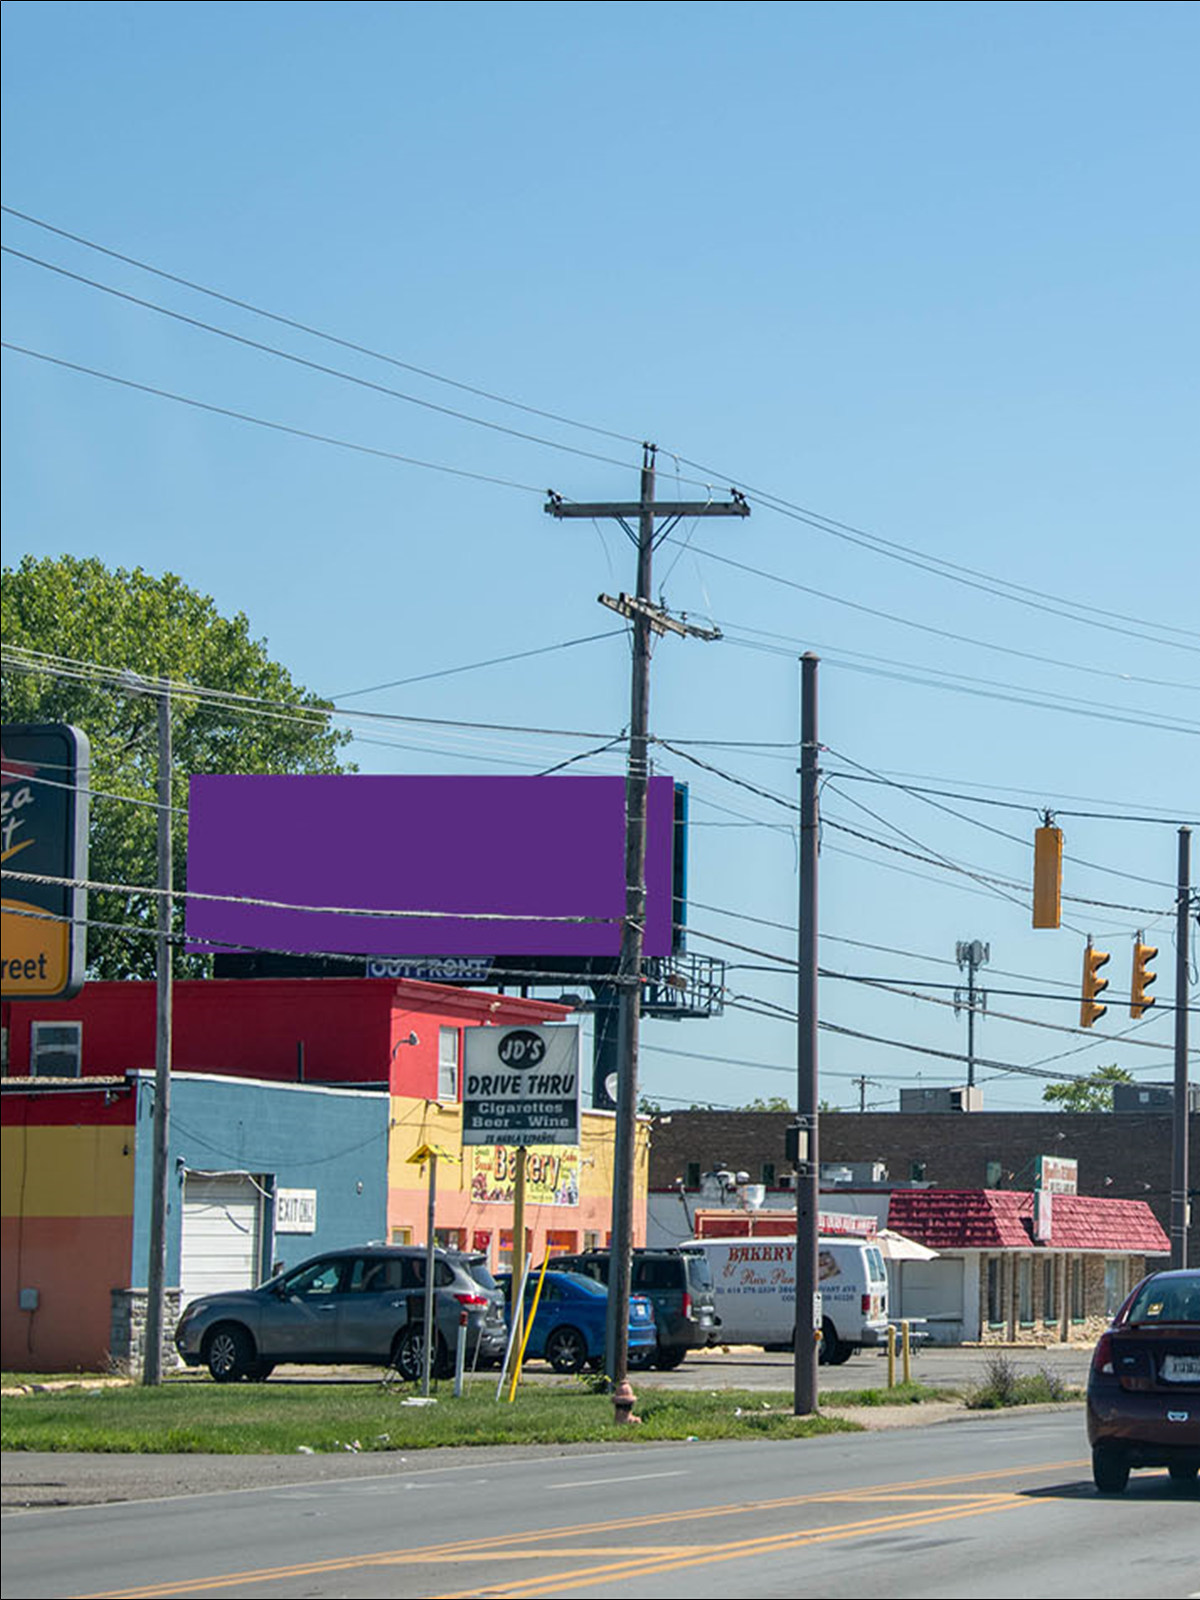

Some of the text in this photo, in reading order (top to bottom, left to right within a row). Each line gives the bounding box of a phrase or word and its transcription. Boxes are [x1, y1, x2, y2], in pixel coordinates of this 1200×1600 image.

[371, 959, 488, 977] OUTFRONT
[501, 1040, 541, 1060] JD'S
[467, 1074, 575, 1096] DRIVE THRU
[478, 1102, 563, 1116] Cigarettes
[472, 1117, 510, 1128] Beer
[528, 1116, 569, 1128] Wine
[279, 1197, 298, 1222] EXIT
[728, 1246, 795, 1263] BAKERY
